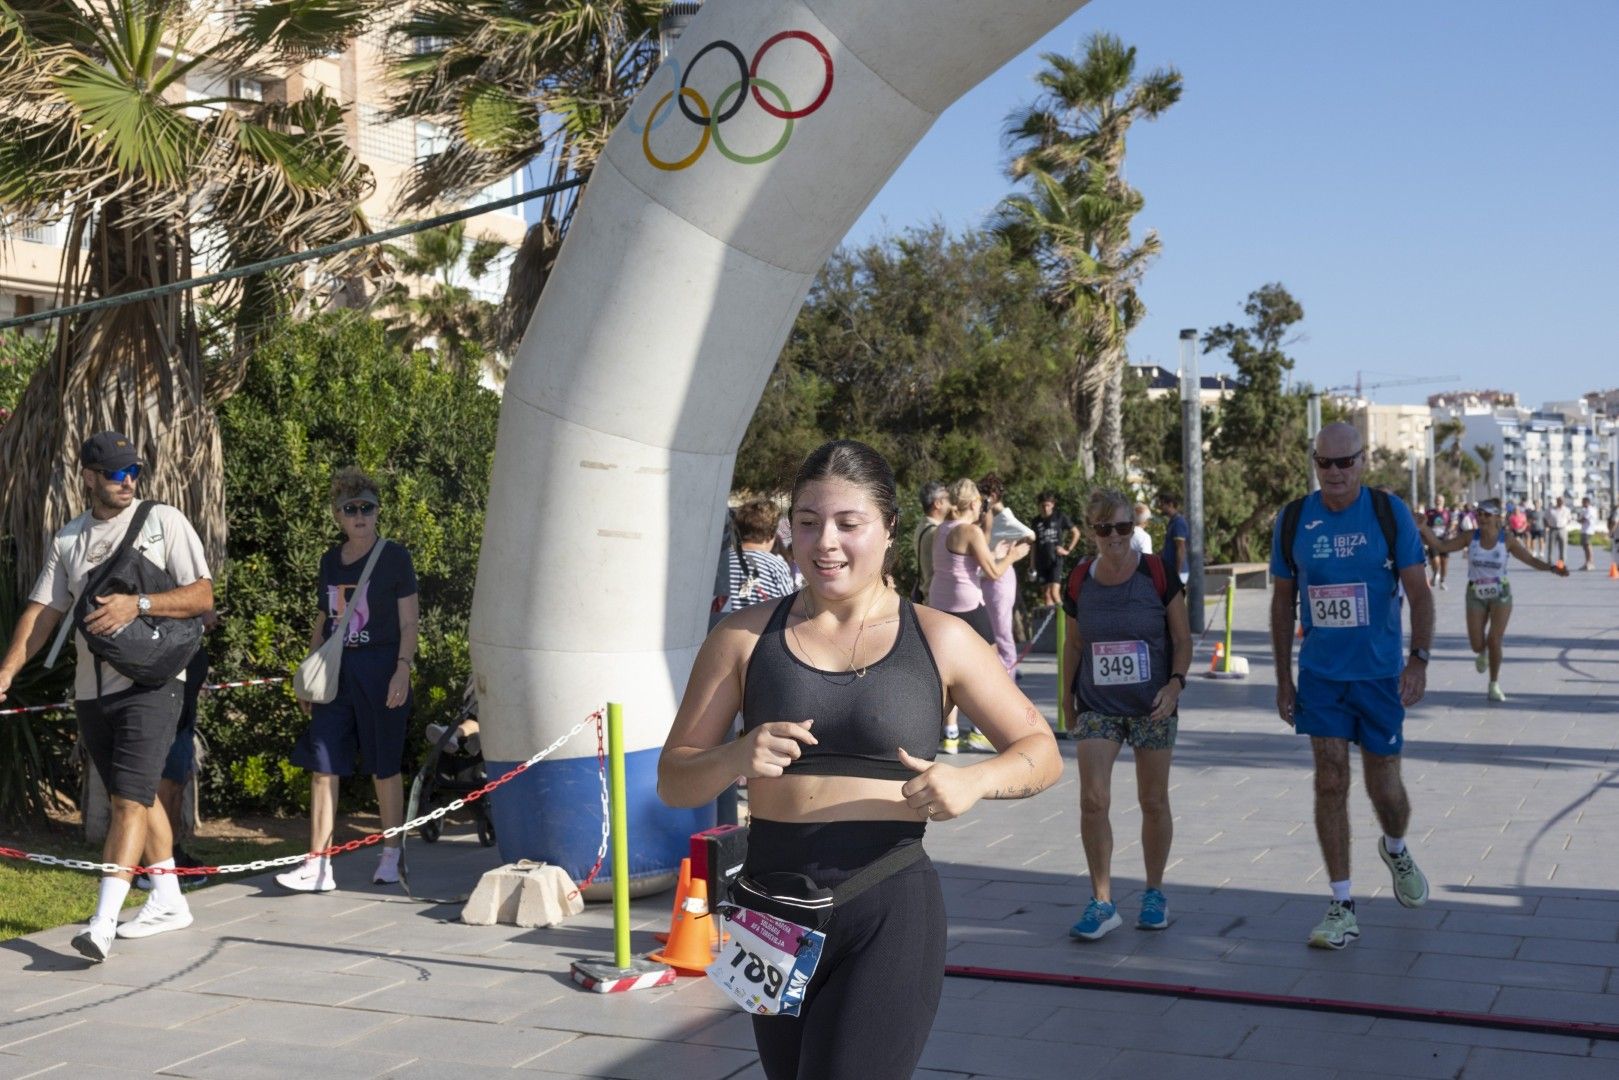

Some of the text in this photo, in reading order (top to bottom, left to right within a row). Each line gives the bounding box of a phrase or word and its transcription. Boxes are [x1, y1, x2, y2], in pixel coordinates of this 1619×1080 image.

[1333, 534, 1367, 547] IBIZA
[1334, 546, 1355, 558] 12K
[1315, 599, 1352, 620] 348
[1099, 655, 1135, 677] 349
[785, 968, 809, 999] KM
